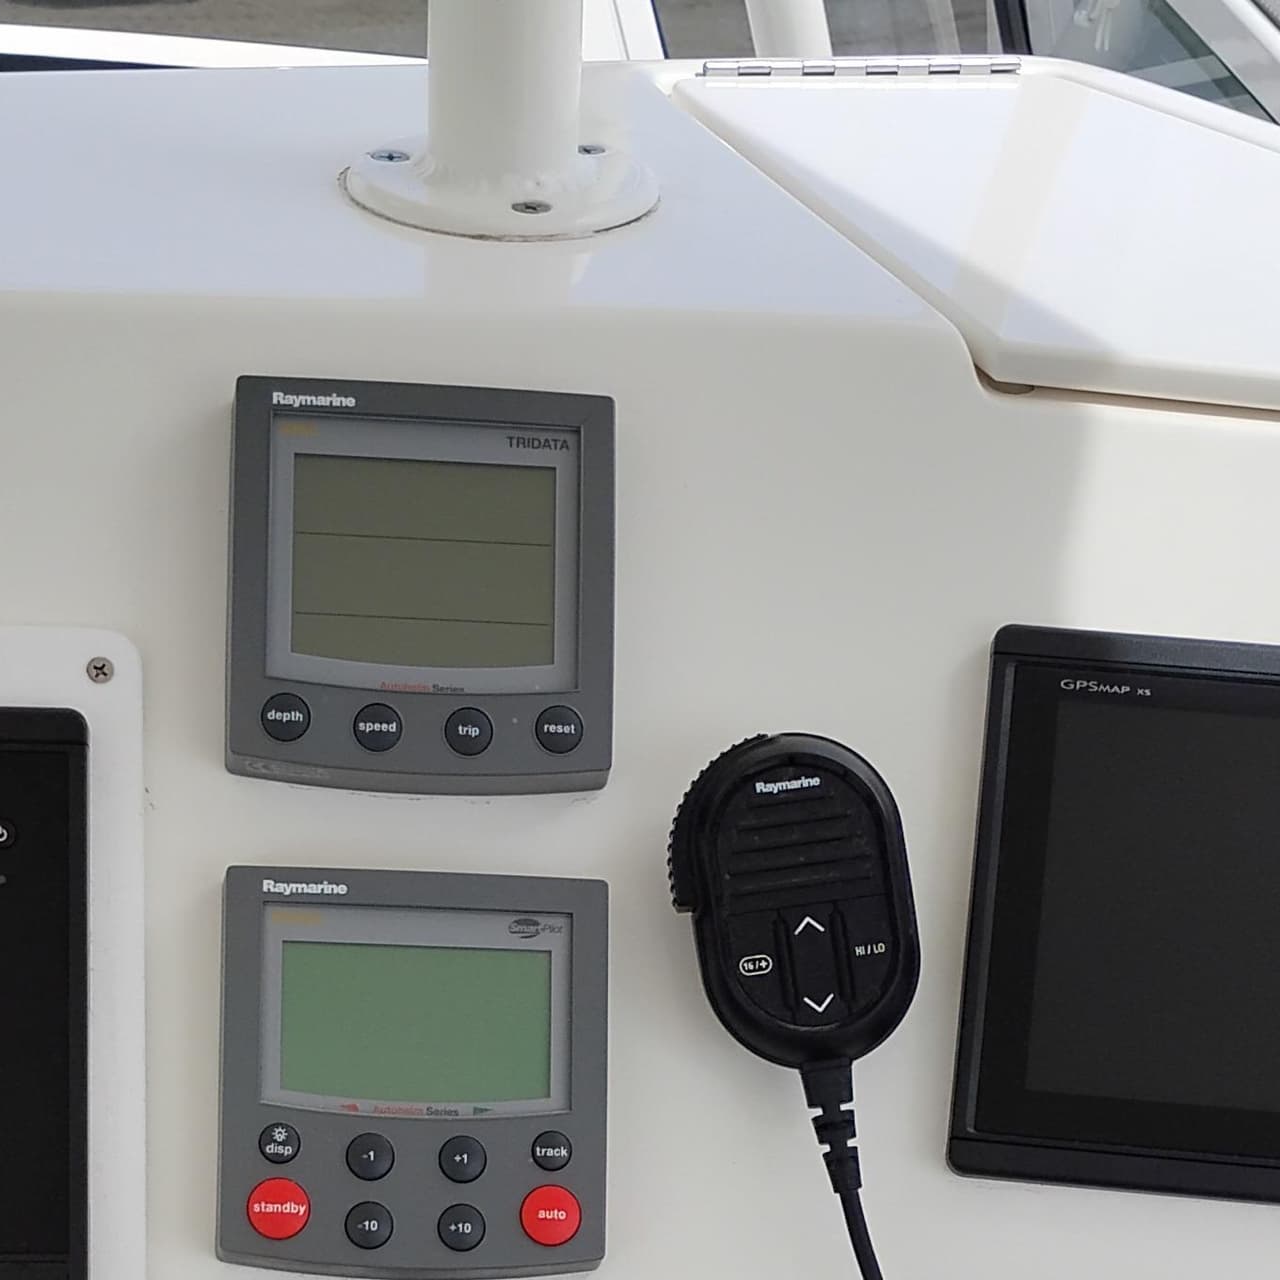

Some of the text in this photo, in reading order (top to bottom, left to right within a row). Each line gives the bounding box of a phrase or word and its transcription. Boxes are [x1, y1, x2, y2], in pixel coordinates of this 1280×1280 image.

[272, 391, 356, 408] Raymarine
[506, 435, 571, 452] TRIDATA
[1060, 679, 1131, 694] GPSMAP
[267, 709, 304, 725] depth
[358, 718, 397, 735] speed
[458, 723, 480, 740] trip
[544, 722, 576, 736] reset
[755, 775, 821, 795] Raymarine
[263, 879, 348, 897] Raymarine
[265, 1142, 293, 1157] disp
[361, 1149, 375, 1162] -1
[536, 1144, 568, 1158] track
[453, 1152, 469, 1165] +1
[253, 1200, 307, 1216] standby
[538, 1207, 567, 1220] auto
[357, 1219, 378, 1232] -10
[448, 1221, 472, 1234] +10
